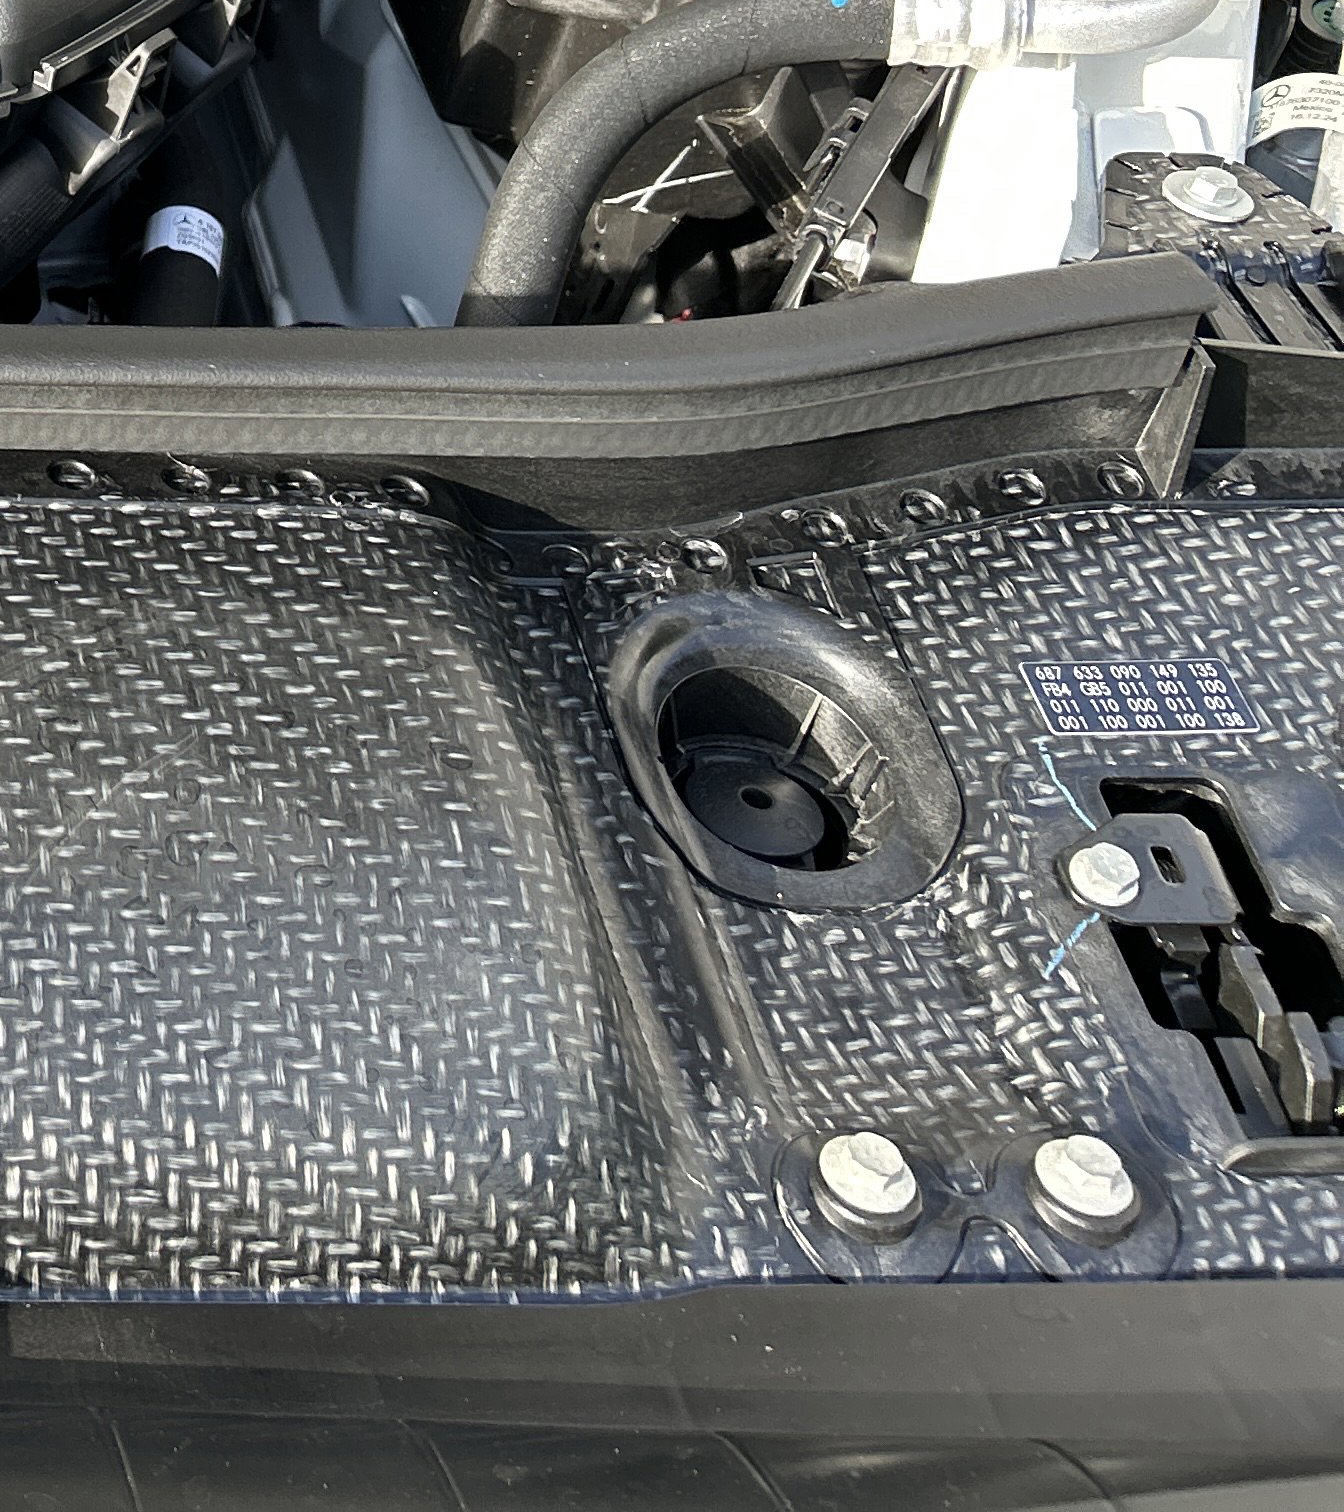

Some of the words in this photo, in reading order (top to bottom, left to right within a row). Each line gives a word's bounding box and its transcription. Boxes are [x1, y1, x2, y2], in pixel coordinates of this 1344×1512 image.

[1036, 666, 1061, 680] 687
[1074, 666, 1103, 680] 633
[1110, 665, 1141, 679] 090
[1150, 665, 1178, 678] 149
[1188, 664, 1218, 677] 135
[1119, 682, 1149, 696] 011
[1158, 681, 1187, 694] 001
[1197, 680, 1226, 694] 100
[1050, 699, 1080, 713] 011
[1090, 699, 1119, 712] 110
[1127, 698, 1158, 712] 000
[1166, 697, 1195, 711] 011
[1204, 696, 1235, 710] 001
[1059, 716, 1088, 730] 001
[1098, 715, 1128, 729] 100
[1136, 715, 1165, 729] 001
[1176, 714, 1205, 728] 100
